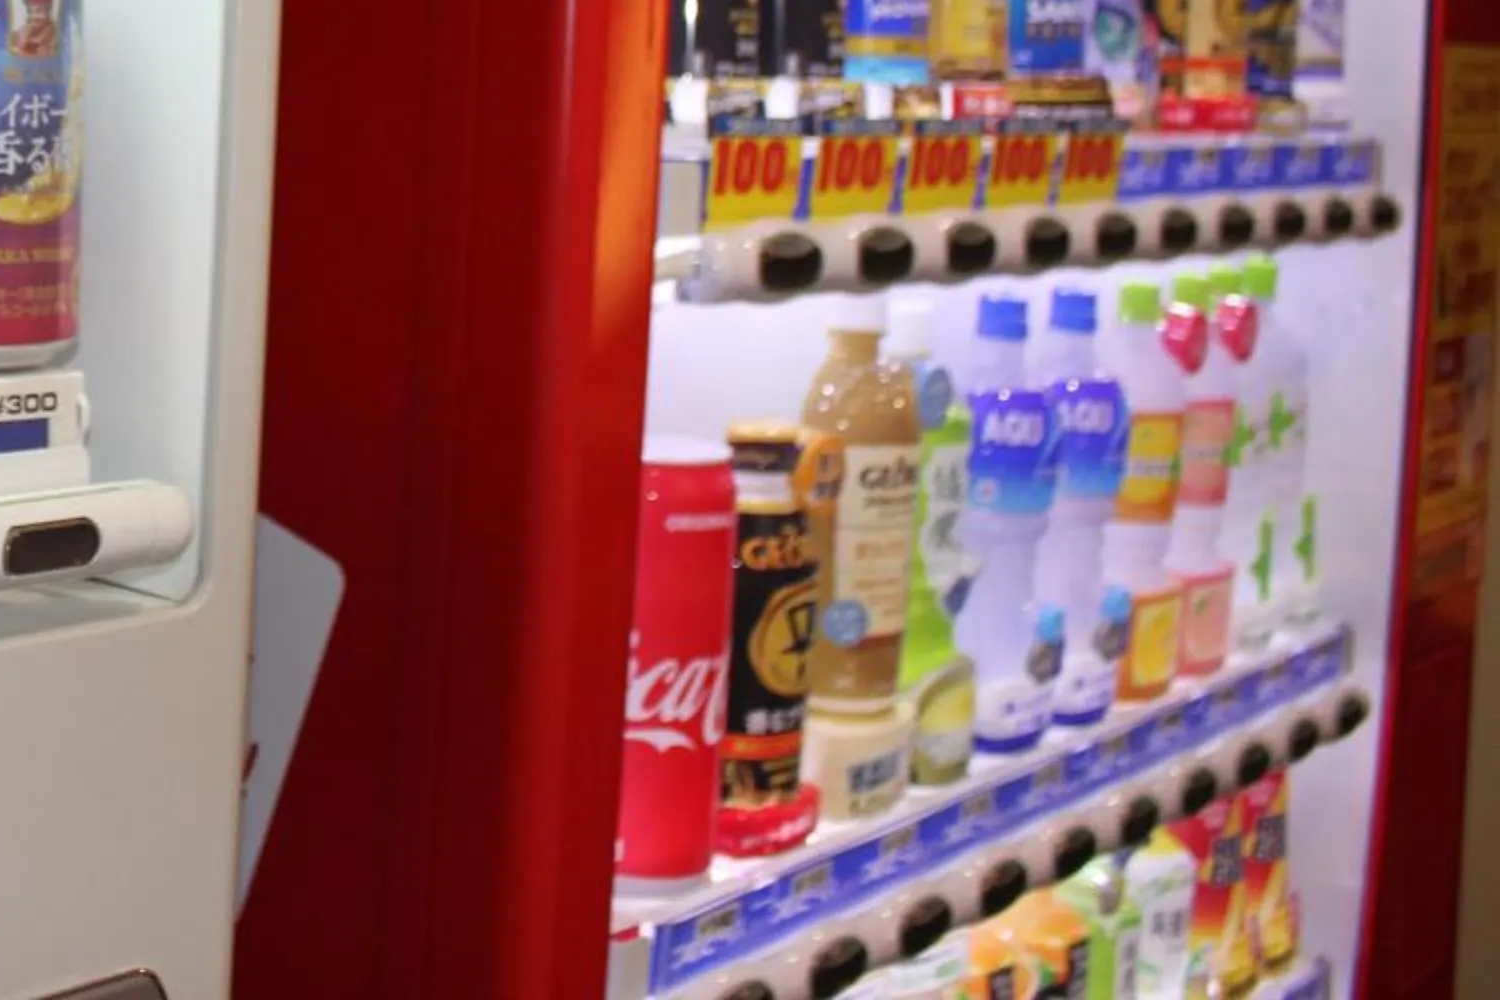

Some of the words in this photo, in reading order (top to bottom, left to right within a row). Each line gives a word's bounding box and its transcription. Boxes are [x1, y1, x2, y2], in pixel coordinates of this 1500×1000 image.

[714, 138, 787, 196] 100
[818, 137, 883, 194] 100
[911, 137, 969, 189] 100
